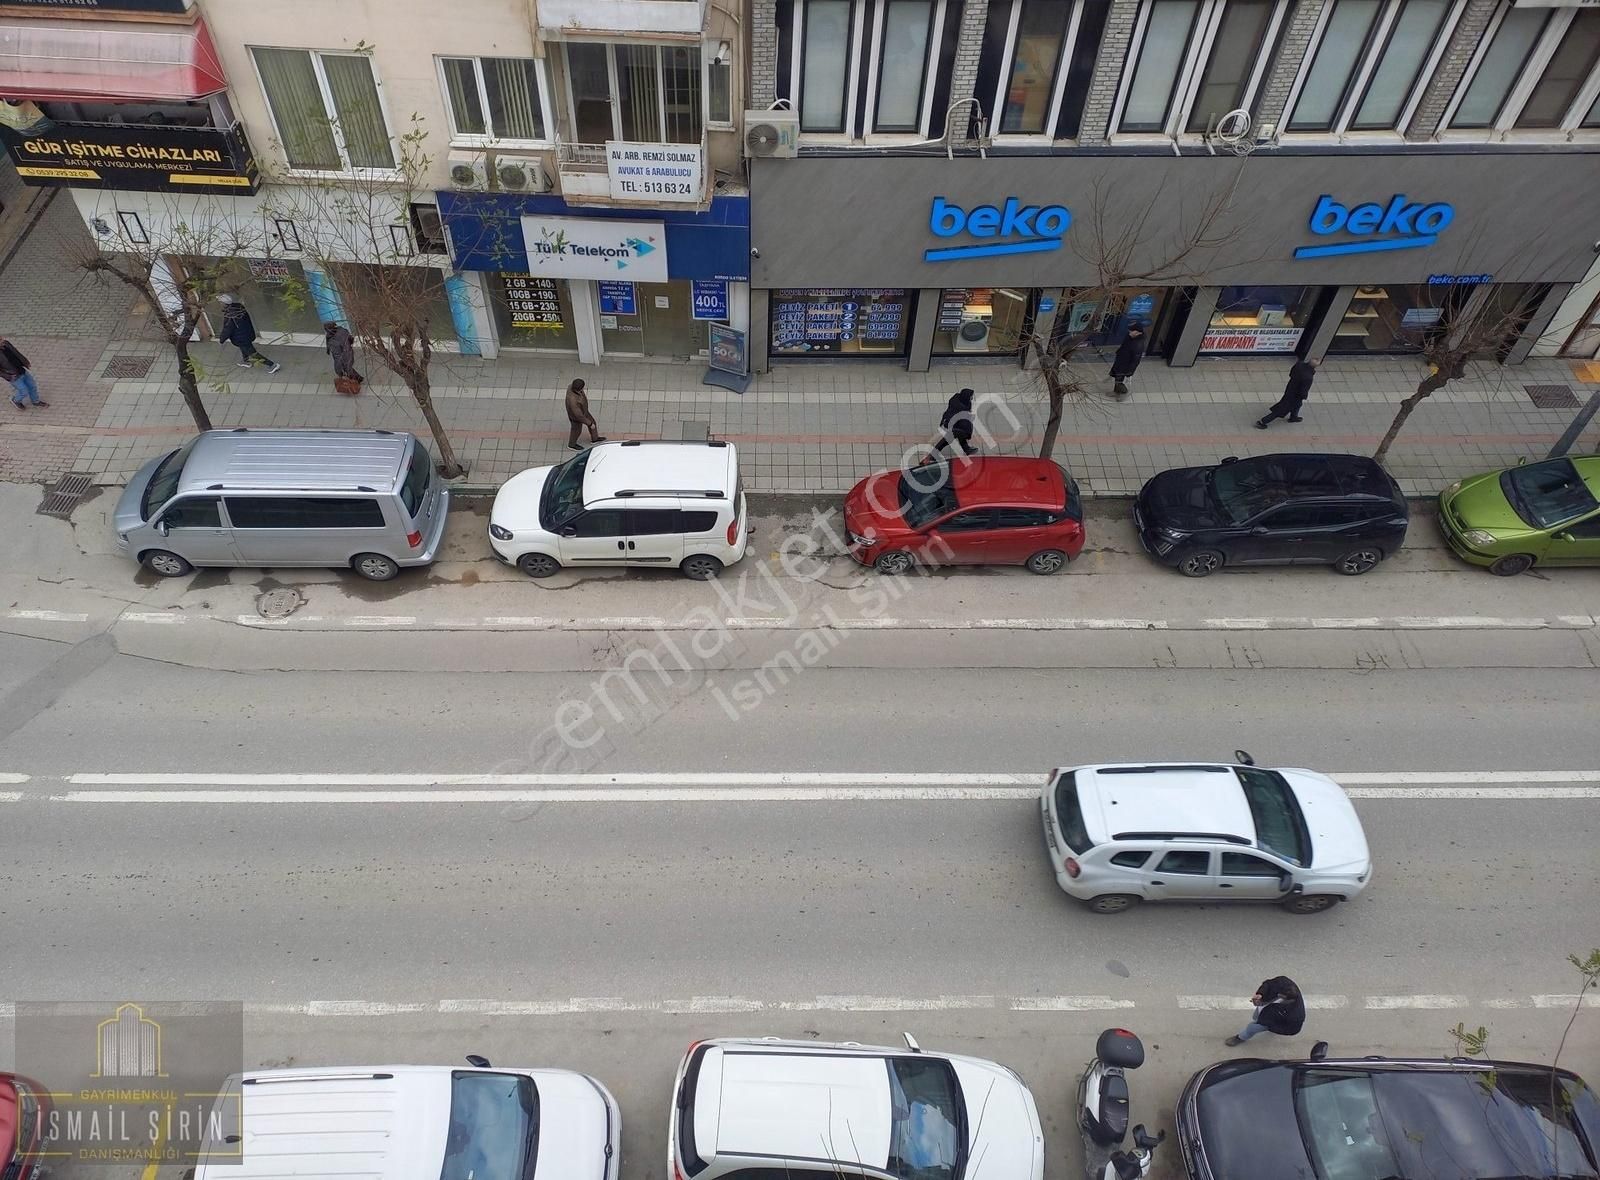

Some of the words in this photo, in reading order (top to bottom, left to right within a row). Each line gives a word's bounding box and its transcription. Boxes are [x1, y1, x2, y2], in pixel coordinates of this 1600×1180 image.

[24, 139, 64, 155] GÜR
[63, 140, 125, 158] İŞİTME
[126, 143, 221, 162] CİHAZLARI
[612, 151, 622, 160] AV.
[625, 152, 641, 160] ARB.
[643, 152, 665, 161] REMZİ
[667, 152, 695, 162] SOLMAZ
[65, 159, 89, 167] SATIŞ
[103, 161, 154, 169] UYGULAMA
[155, 163, 192, 171] MERKEZİ
[618, 167, 644, 175] AVUKAT
[652, 168, 691, 176] ARABULUCU
[621, 181, 637, 192] TEL
[645, 182, 662, 193] 513
[665, 183, 676, 193] 63
[679, 184, 691, 194] 24
[931, 197, 1072, 238] beko
[1309, 195, 1456, 236] beko
[570, 244, 629, 257] Telekom
[506, 279, 512, 287] 2
[514, 279, 526, 287] GB
[1428, 275, 1492, 284] beko.com.tr
[508, 290, 531, 299] 10GB
[510, 302, 520, 310] 15
[696, 295, 718, 307] 400
[512, 312, 535, 321] 20GB
